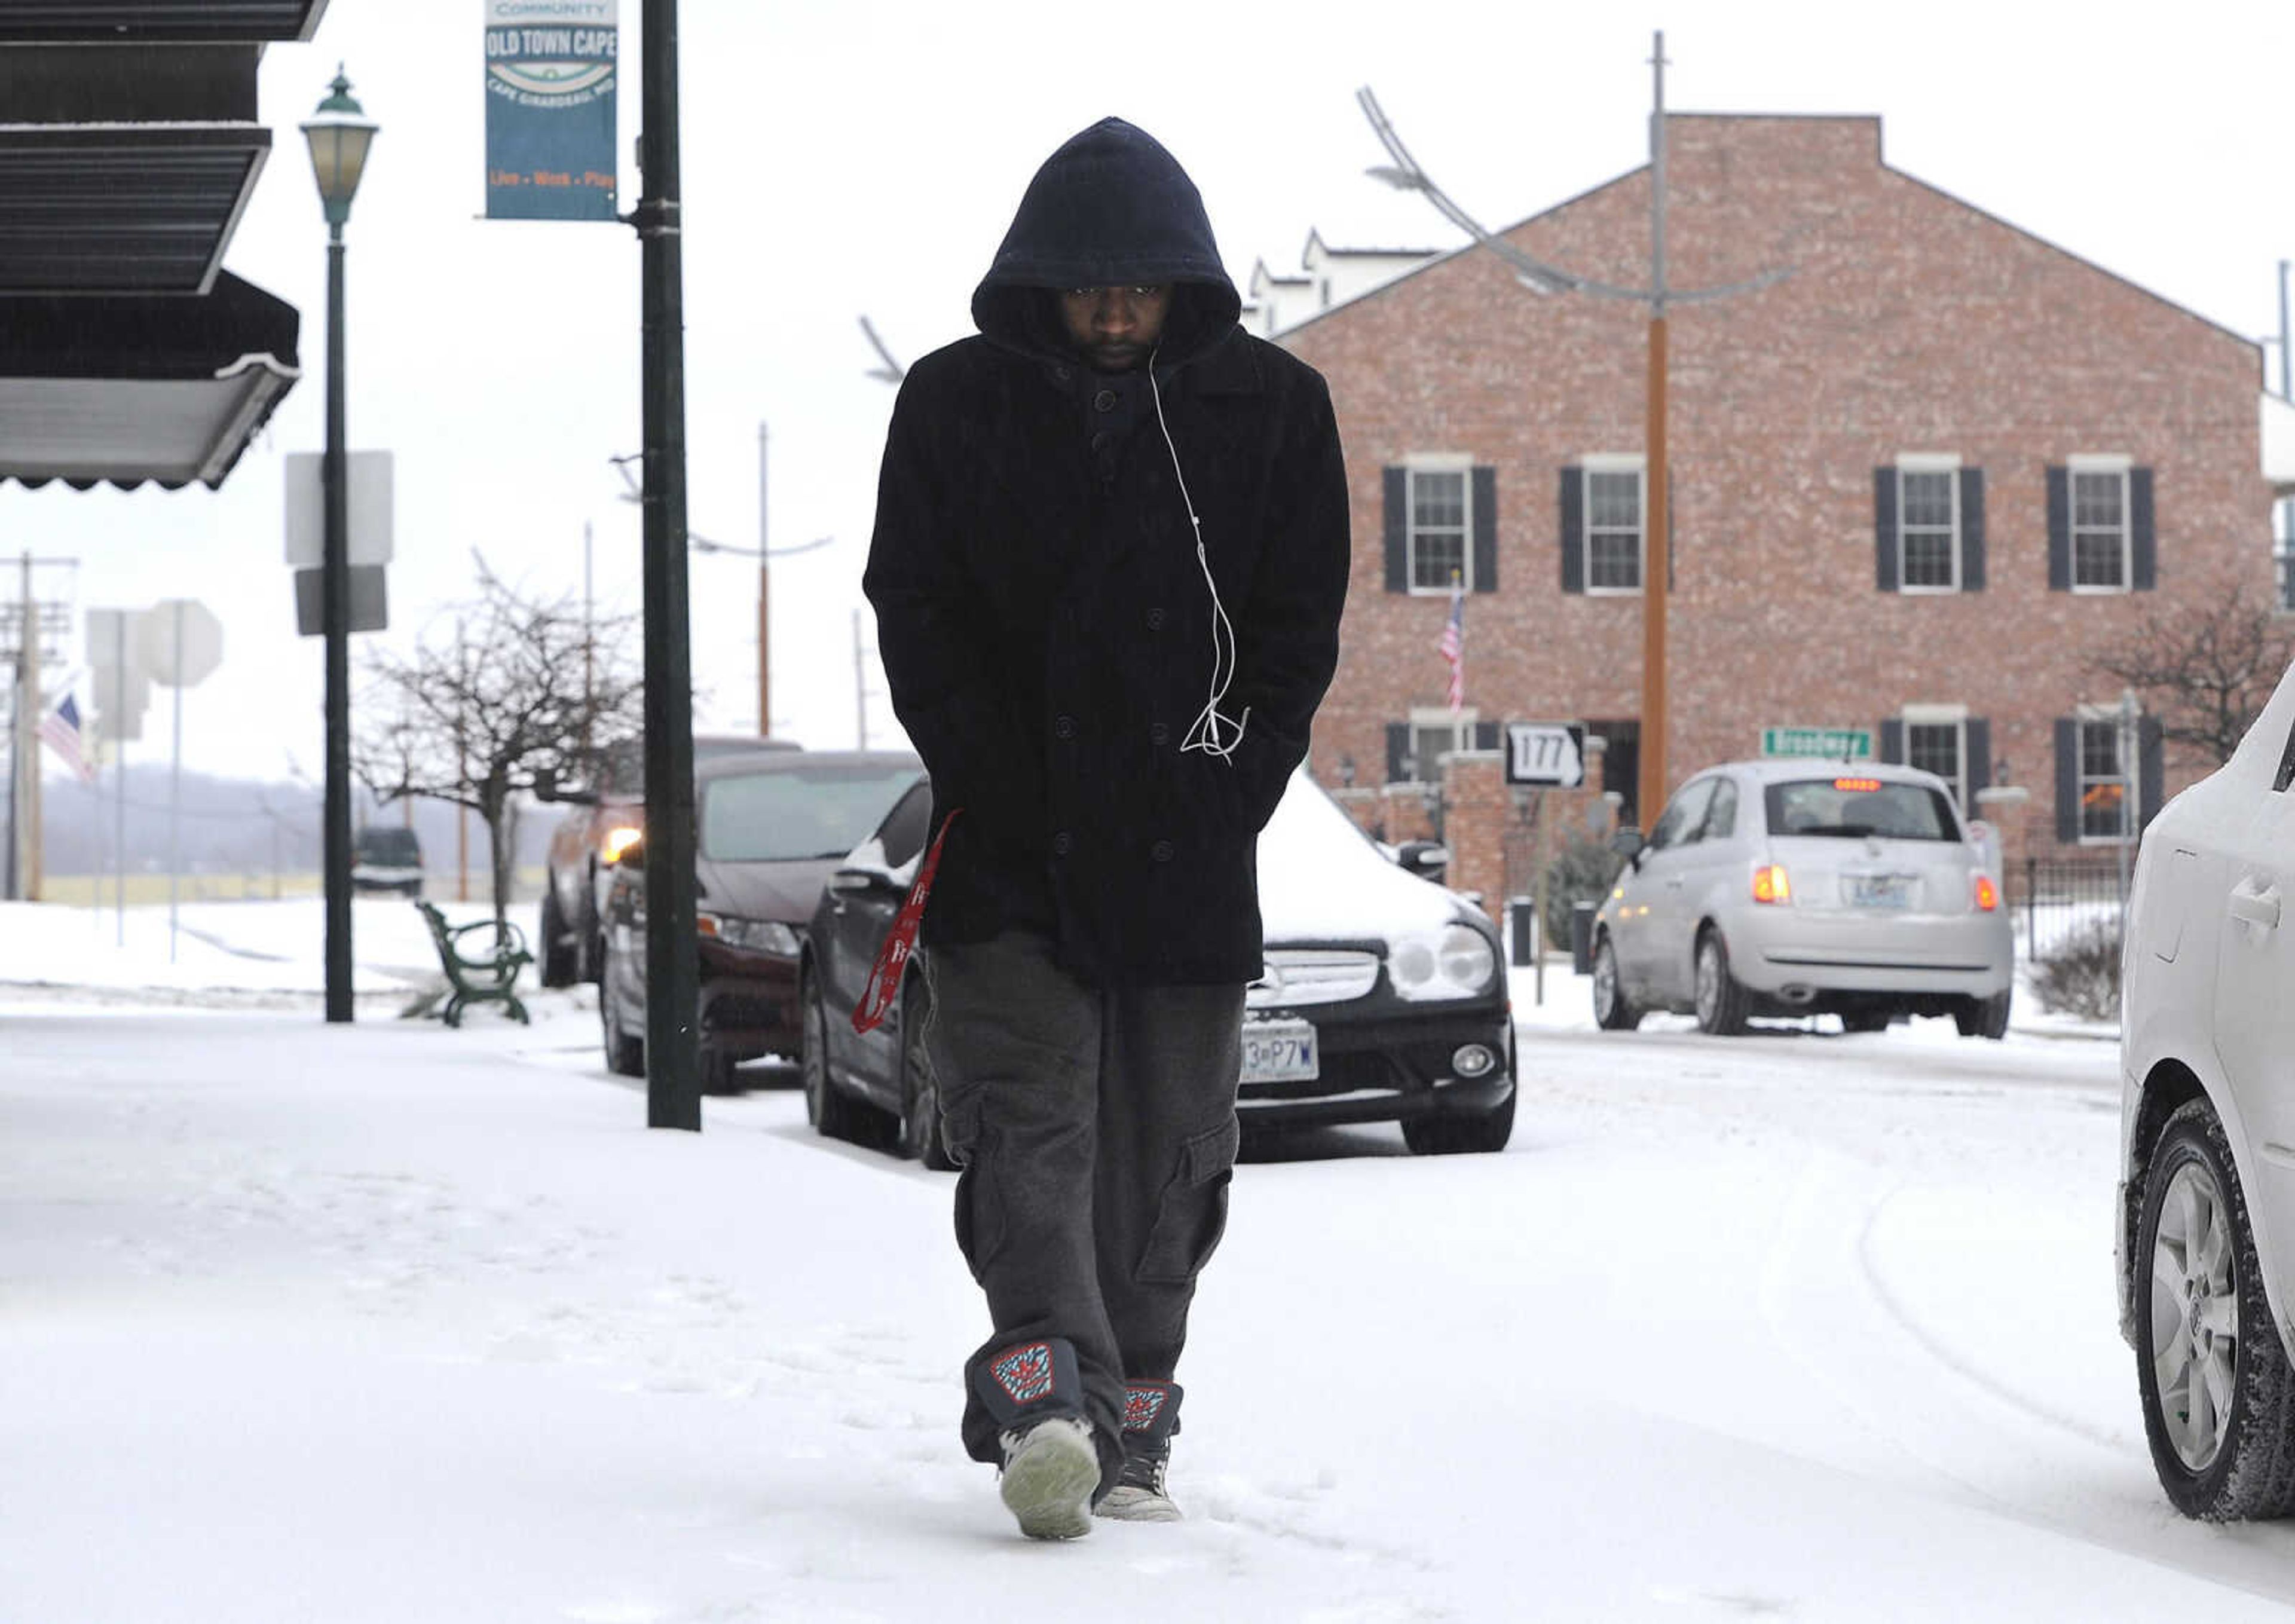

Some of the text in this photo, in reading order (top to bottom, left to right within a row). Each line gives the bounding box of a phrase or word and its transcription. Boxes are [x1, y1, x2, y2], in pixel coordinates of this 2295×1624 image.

[495, 2, 606, 16] COMMUNITY
[486, 30, 617, 57] OLD TOWN CAPE
[585, 171, 616, 188] Play
[1522, 734, 1565, 768] 177
[1775, 729, 1861, 757] Broadway
